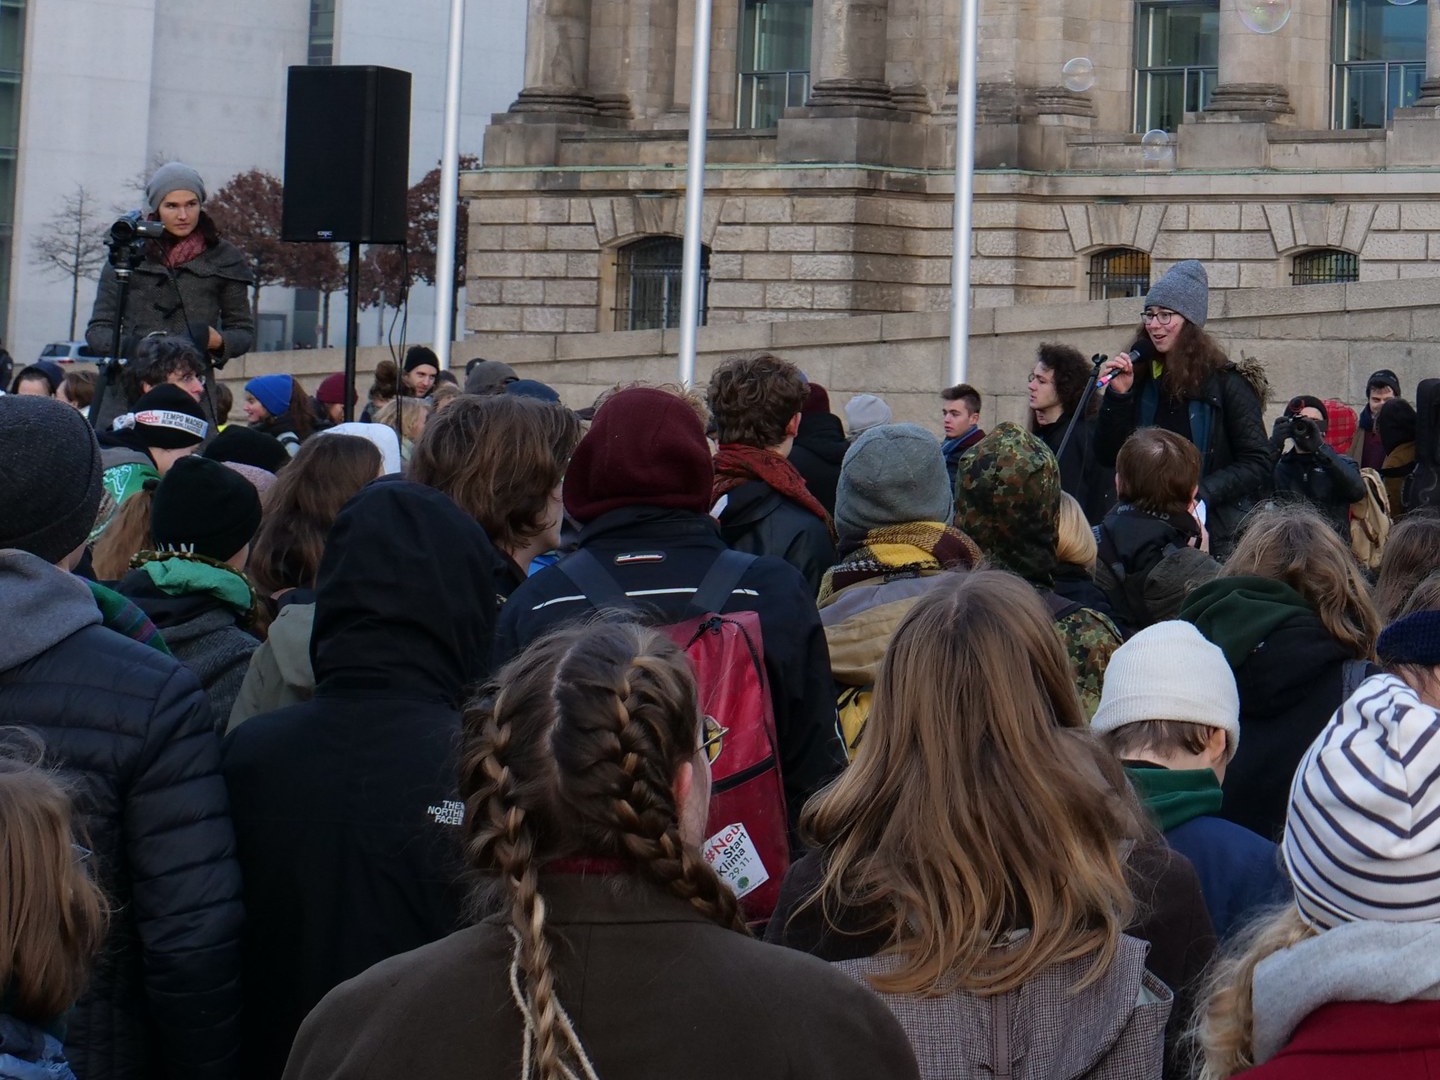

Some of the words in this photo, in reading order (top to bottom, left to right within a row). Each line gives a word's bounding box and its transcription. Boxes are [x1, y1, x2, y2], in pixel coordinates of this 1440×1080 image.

[427, 805, 460, 818] NORTH
[442, 800, 461, 810] THE
[434, 815, 459, 825] FACE
[704, 825, 741, 863] #Neu
[723, 831, 747, 859] Start
[716, 848, 746, 877] Klima
[728, 857, 753, 880] 29.11.
